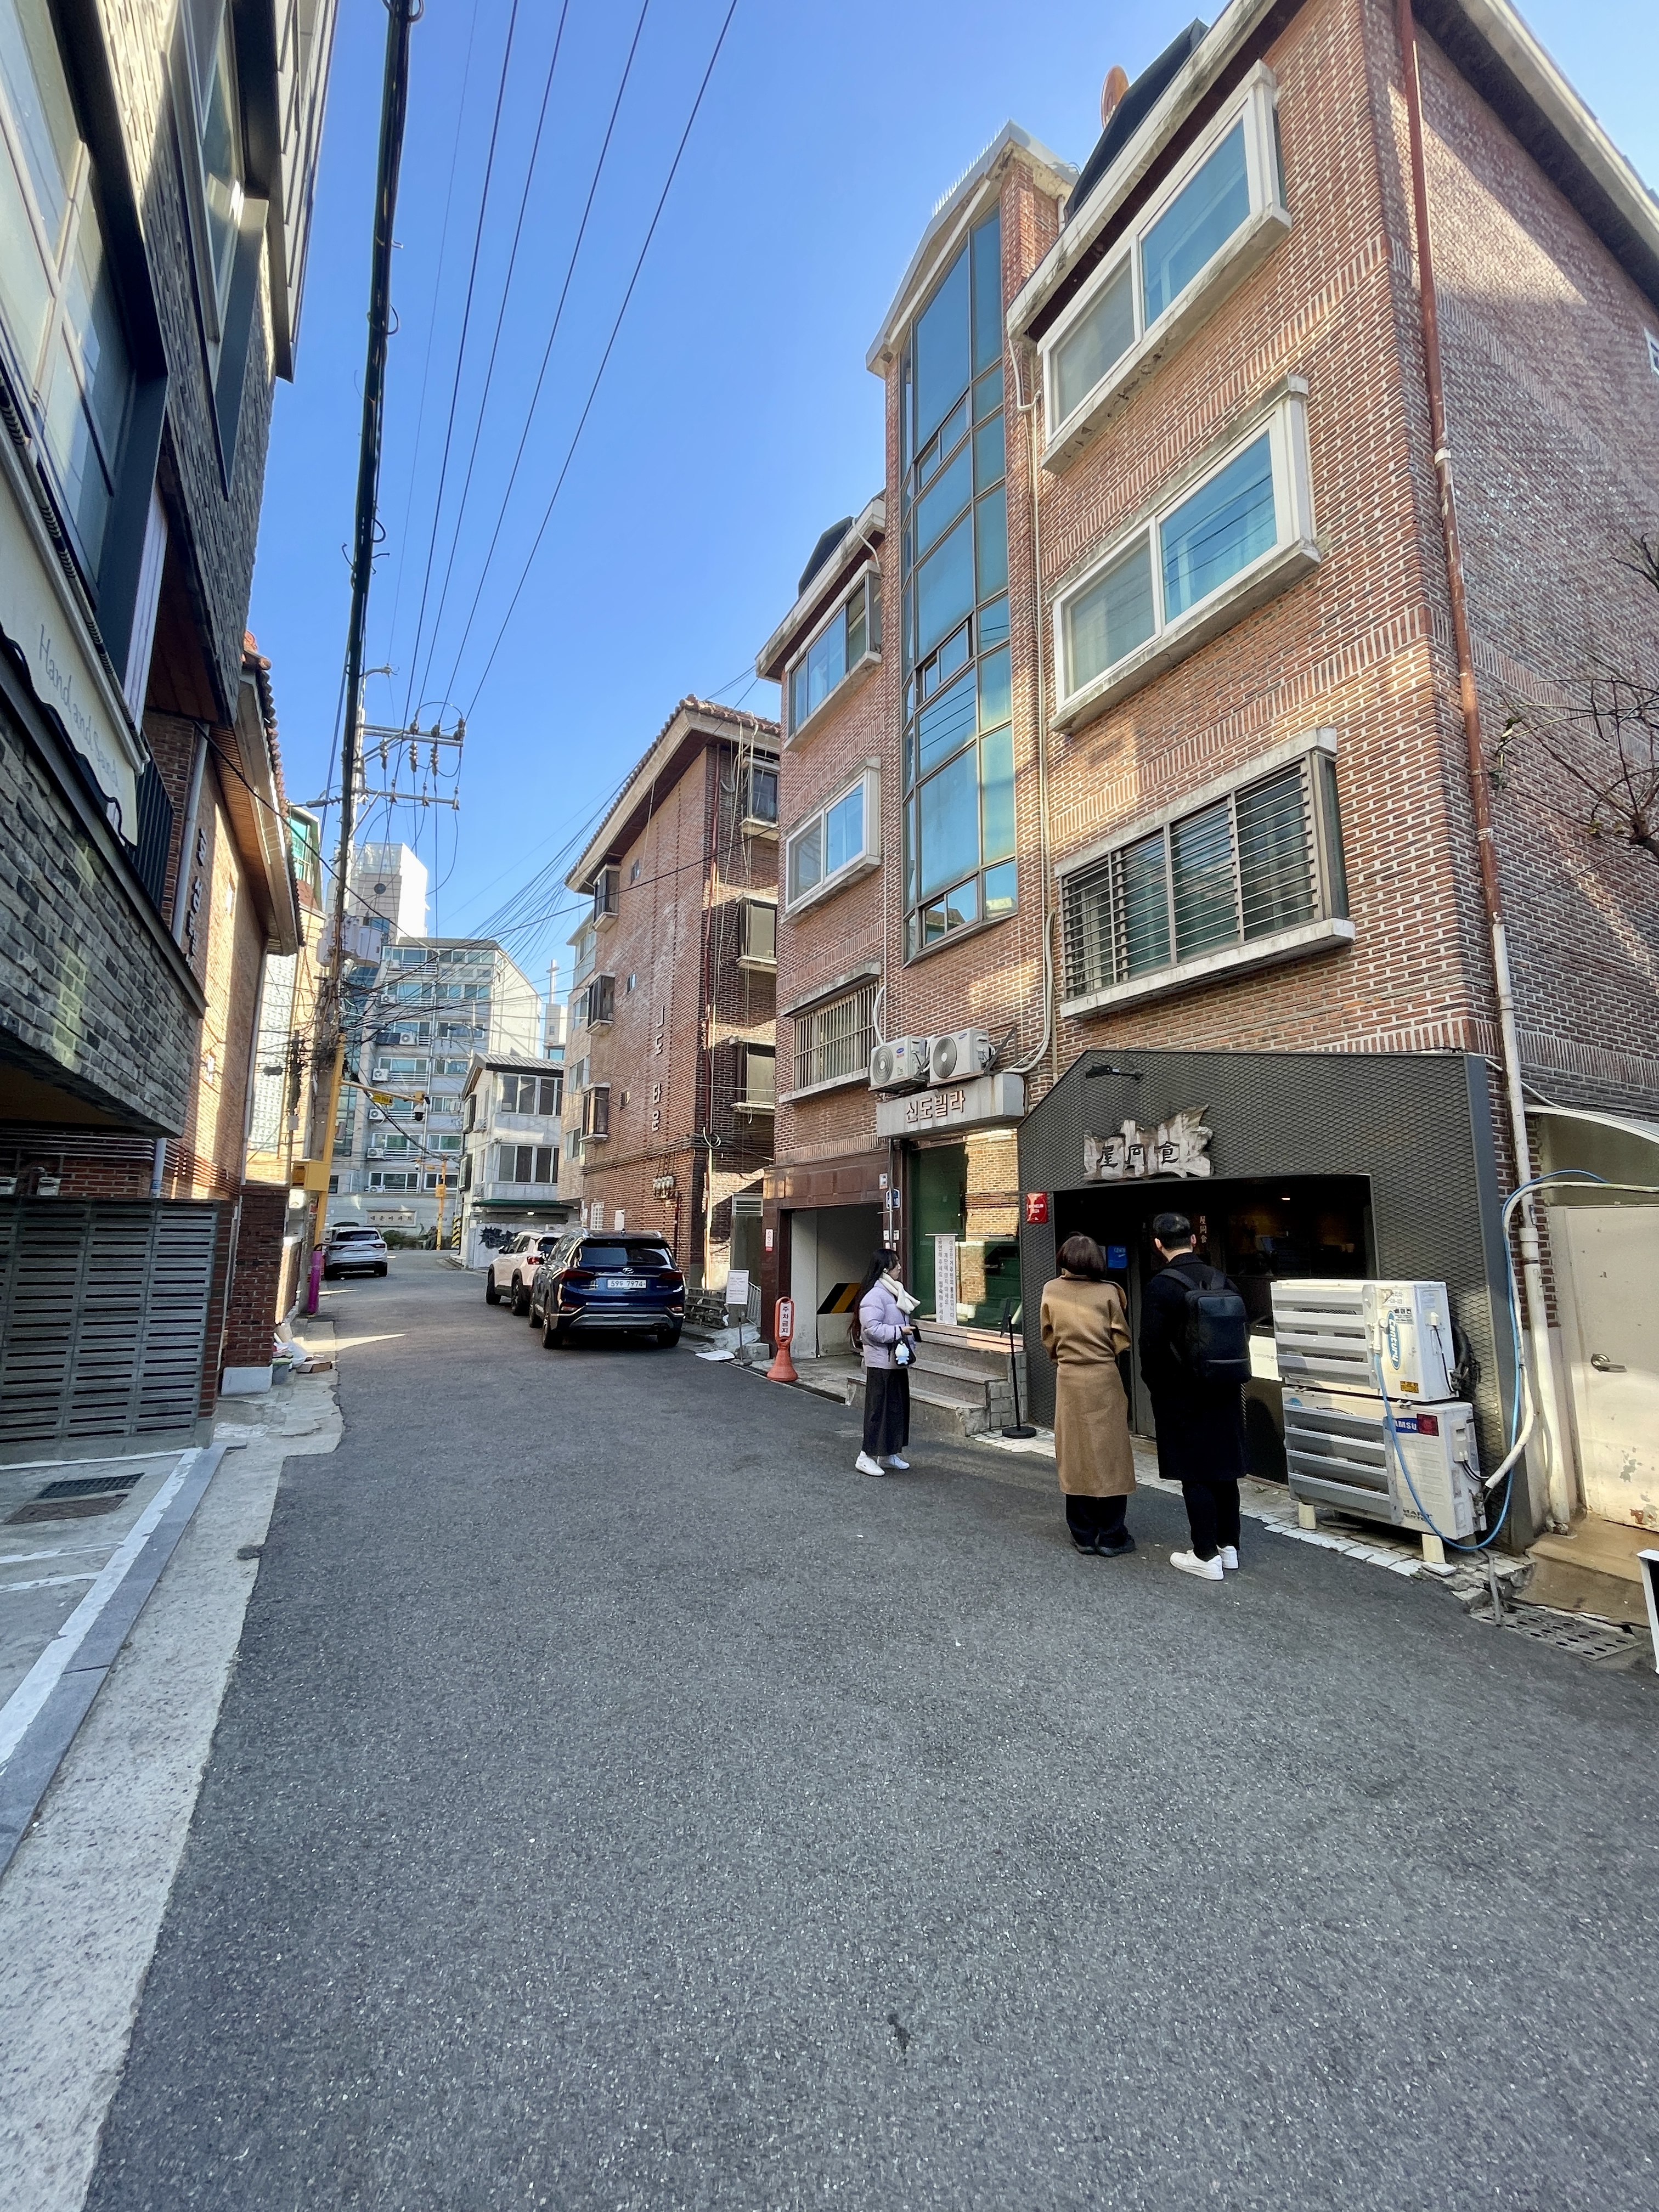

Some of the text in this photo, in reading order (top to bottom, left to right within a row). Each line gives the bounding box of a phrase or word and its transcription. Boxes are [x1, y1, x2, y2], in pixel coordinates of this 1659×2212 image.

[39, 623, 72, 713] Hand
[73, 703, 93, 751] and
[906, 1090, 966, 1123] 신도빌라
[781, 1306, 789, 1334] 주차금지
[1388, 1318, 1399, 1362] Century
